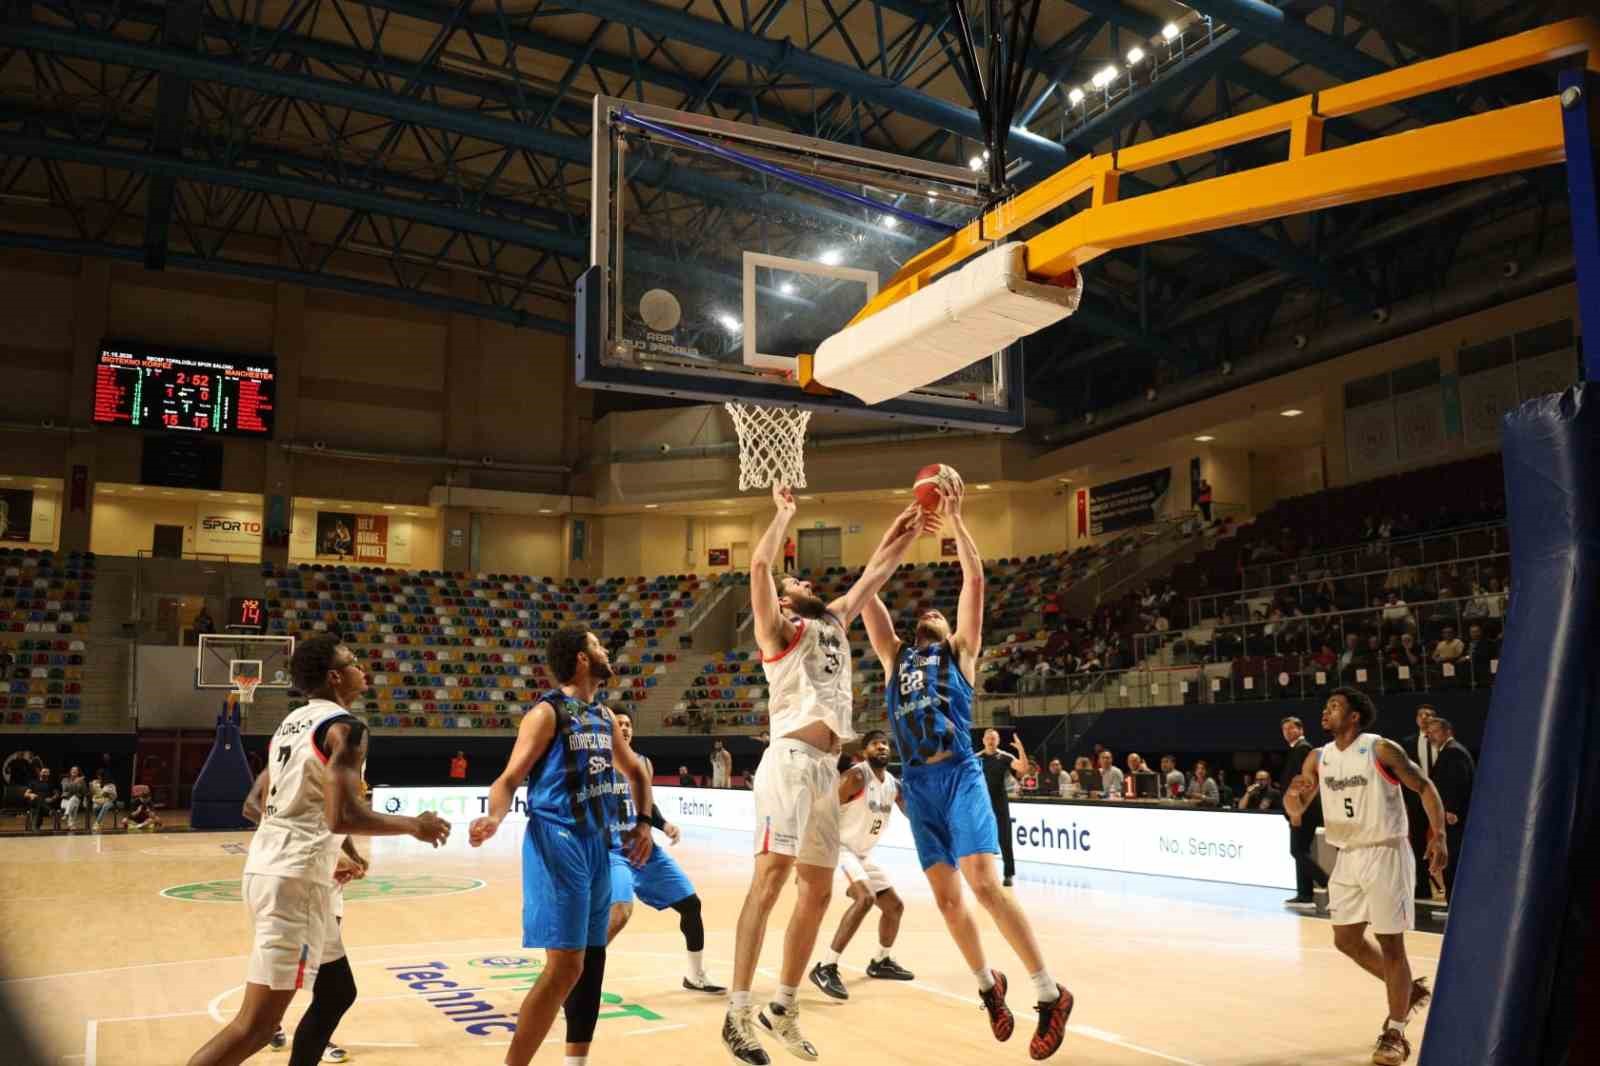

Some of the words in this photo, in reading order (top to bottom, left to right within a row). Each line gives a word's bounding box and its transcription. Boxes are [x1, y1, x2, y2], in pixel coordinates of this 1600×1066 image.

[162, 414, 179, 426] 15
[193, 416, 209, 429] 15
[242, 608, 260, 624] 14
[900, 670, 925, 696] 22
[679, 796, 713, 817] Technic
[1344, 797, 1354, 818] 5
[869, 818, 882, 835] 12
[386, 961, 521, 1036] Technic
